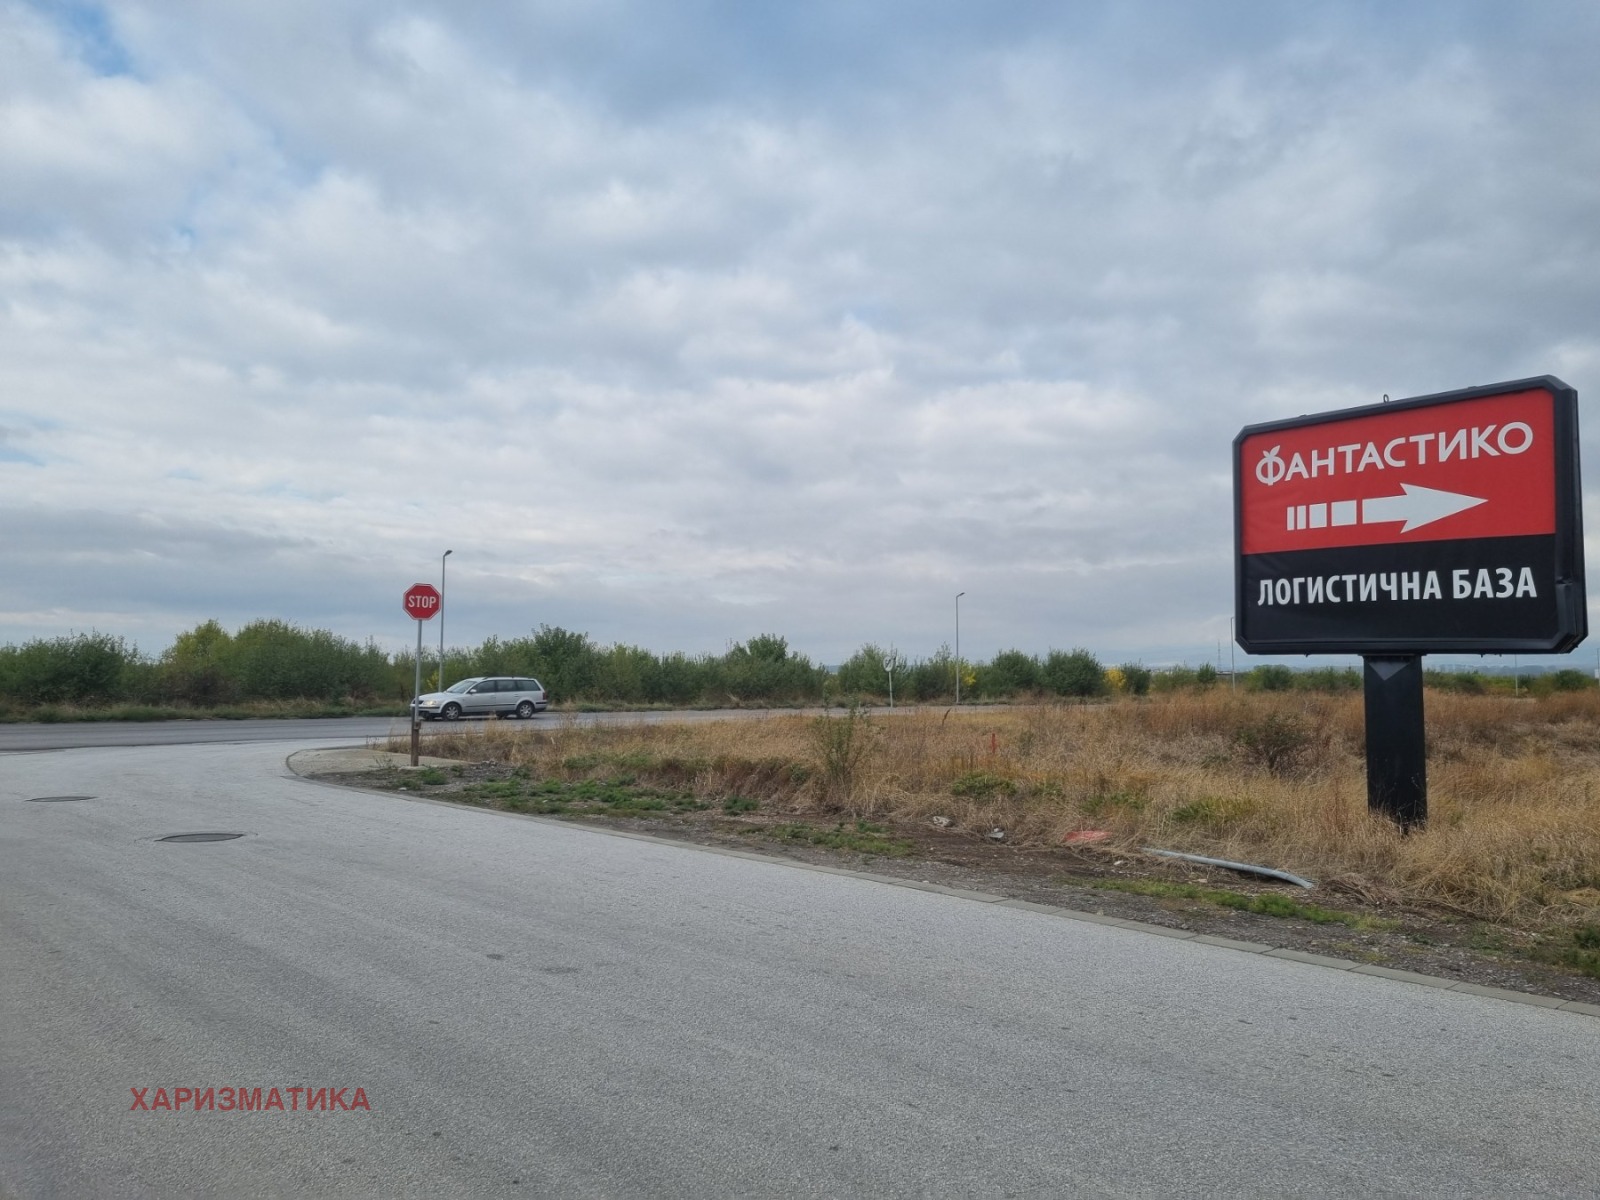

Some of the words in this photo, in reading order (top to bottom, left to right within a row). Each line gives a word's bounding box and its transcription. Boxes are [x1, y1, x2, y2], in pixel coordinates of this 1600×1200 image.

[1255, 421, 1534, 486] ФАНТАСТИКО
[409, 595, 436, 608] STOP
[1257, 570, 1442, 605] ЛОГИСТИЧНА
[1452, 567, 1537, 599] БАЗА
